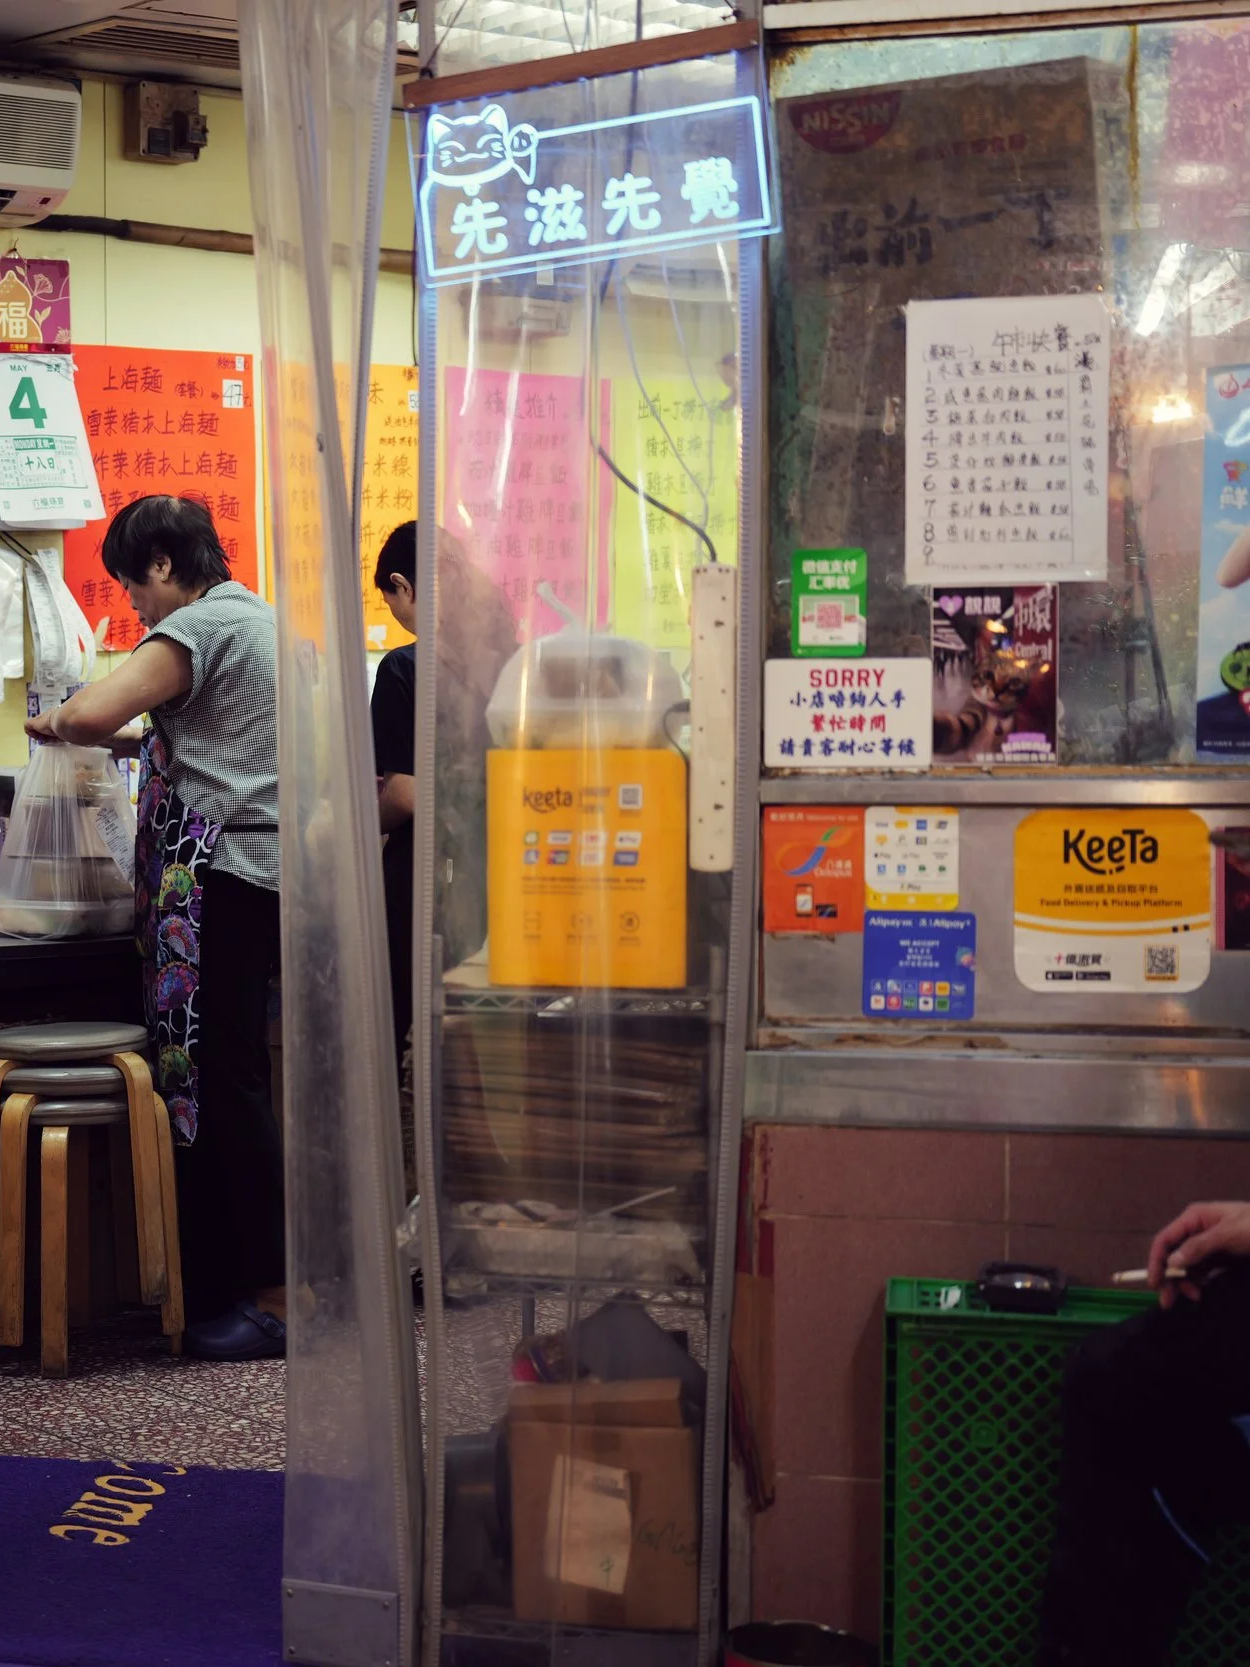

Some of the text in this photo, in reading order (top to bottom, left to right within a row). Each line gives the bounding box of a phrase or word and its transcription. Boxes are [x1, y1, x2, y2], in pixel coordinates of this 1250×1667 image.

[802, 102, 892, 134] NISSIN
[450, 156, 741, 259] 先滋先覺
[10, 364, 29, 372] MAY
[8, 376, 48, 429] 4
[924, 387, 937, 404] 2
[925, 408, 938, 424] 3
[921, 428, 938, 448] 4
[25, 456, 56, 470] 十八日
[924, 452, 938, 468] 5
[922, 474, 936, 491] 6
[924, 498, 937, 518] 7
[923, 522, 935, 542] 8
[1014, 640, 1053, 662] Central
[809, 668, 886, 688] SORRY
[811, 713, 886, 733] 繁忙時間
[780, 738, 916, 757] 請貴客耐心等候
[522, 786, 574, 814] keeta
[1063, 828, 1159, 876] KeeTa
[1040, 898, 1061, 907] Food
[1063, 898, 1100, 908] Delivery
[1111, 898, 1141, 908] Pickup
[1143, 898, 1183, 907] Platform
[49, 1463, 187, 1546] ome
